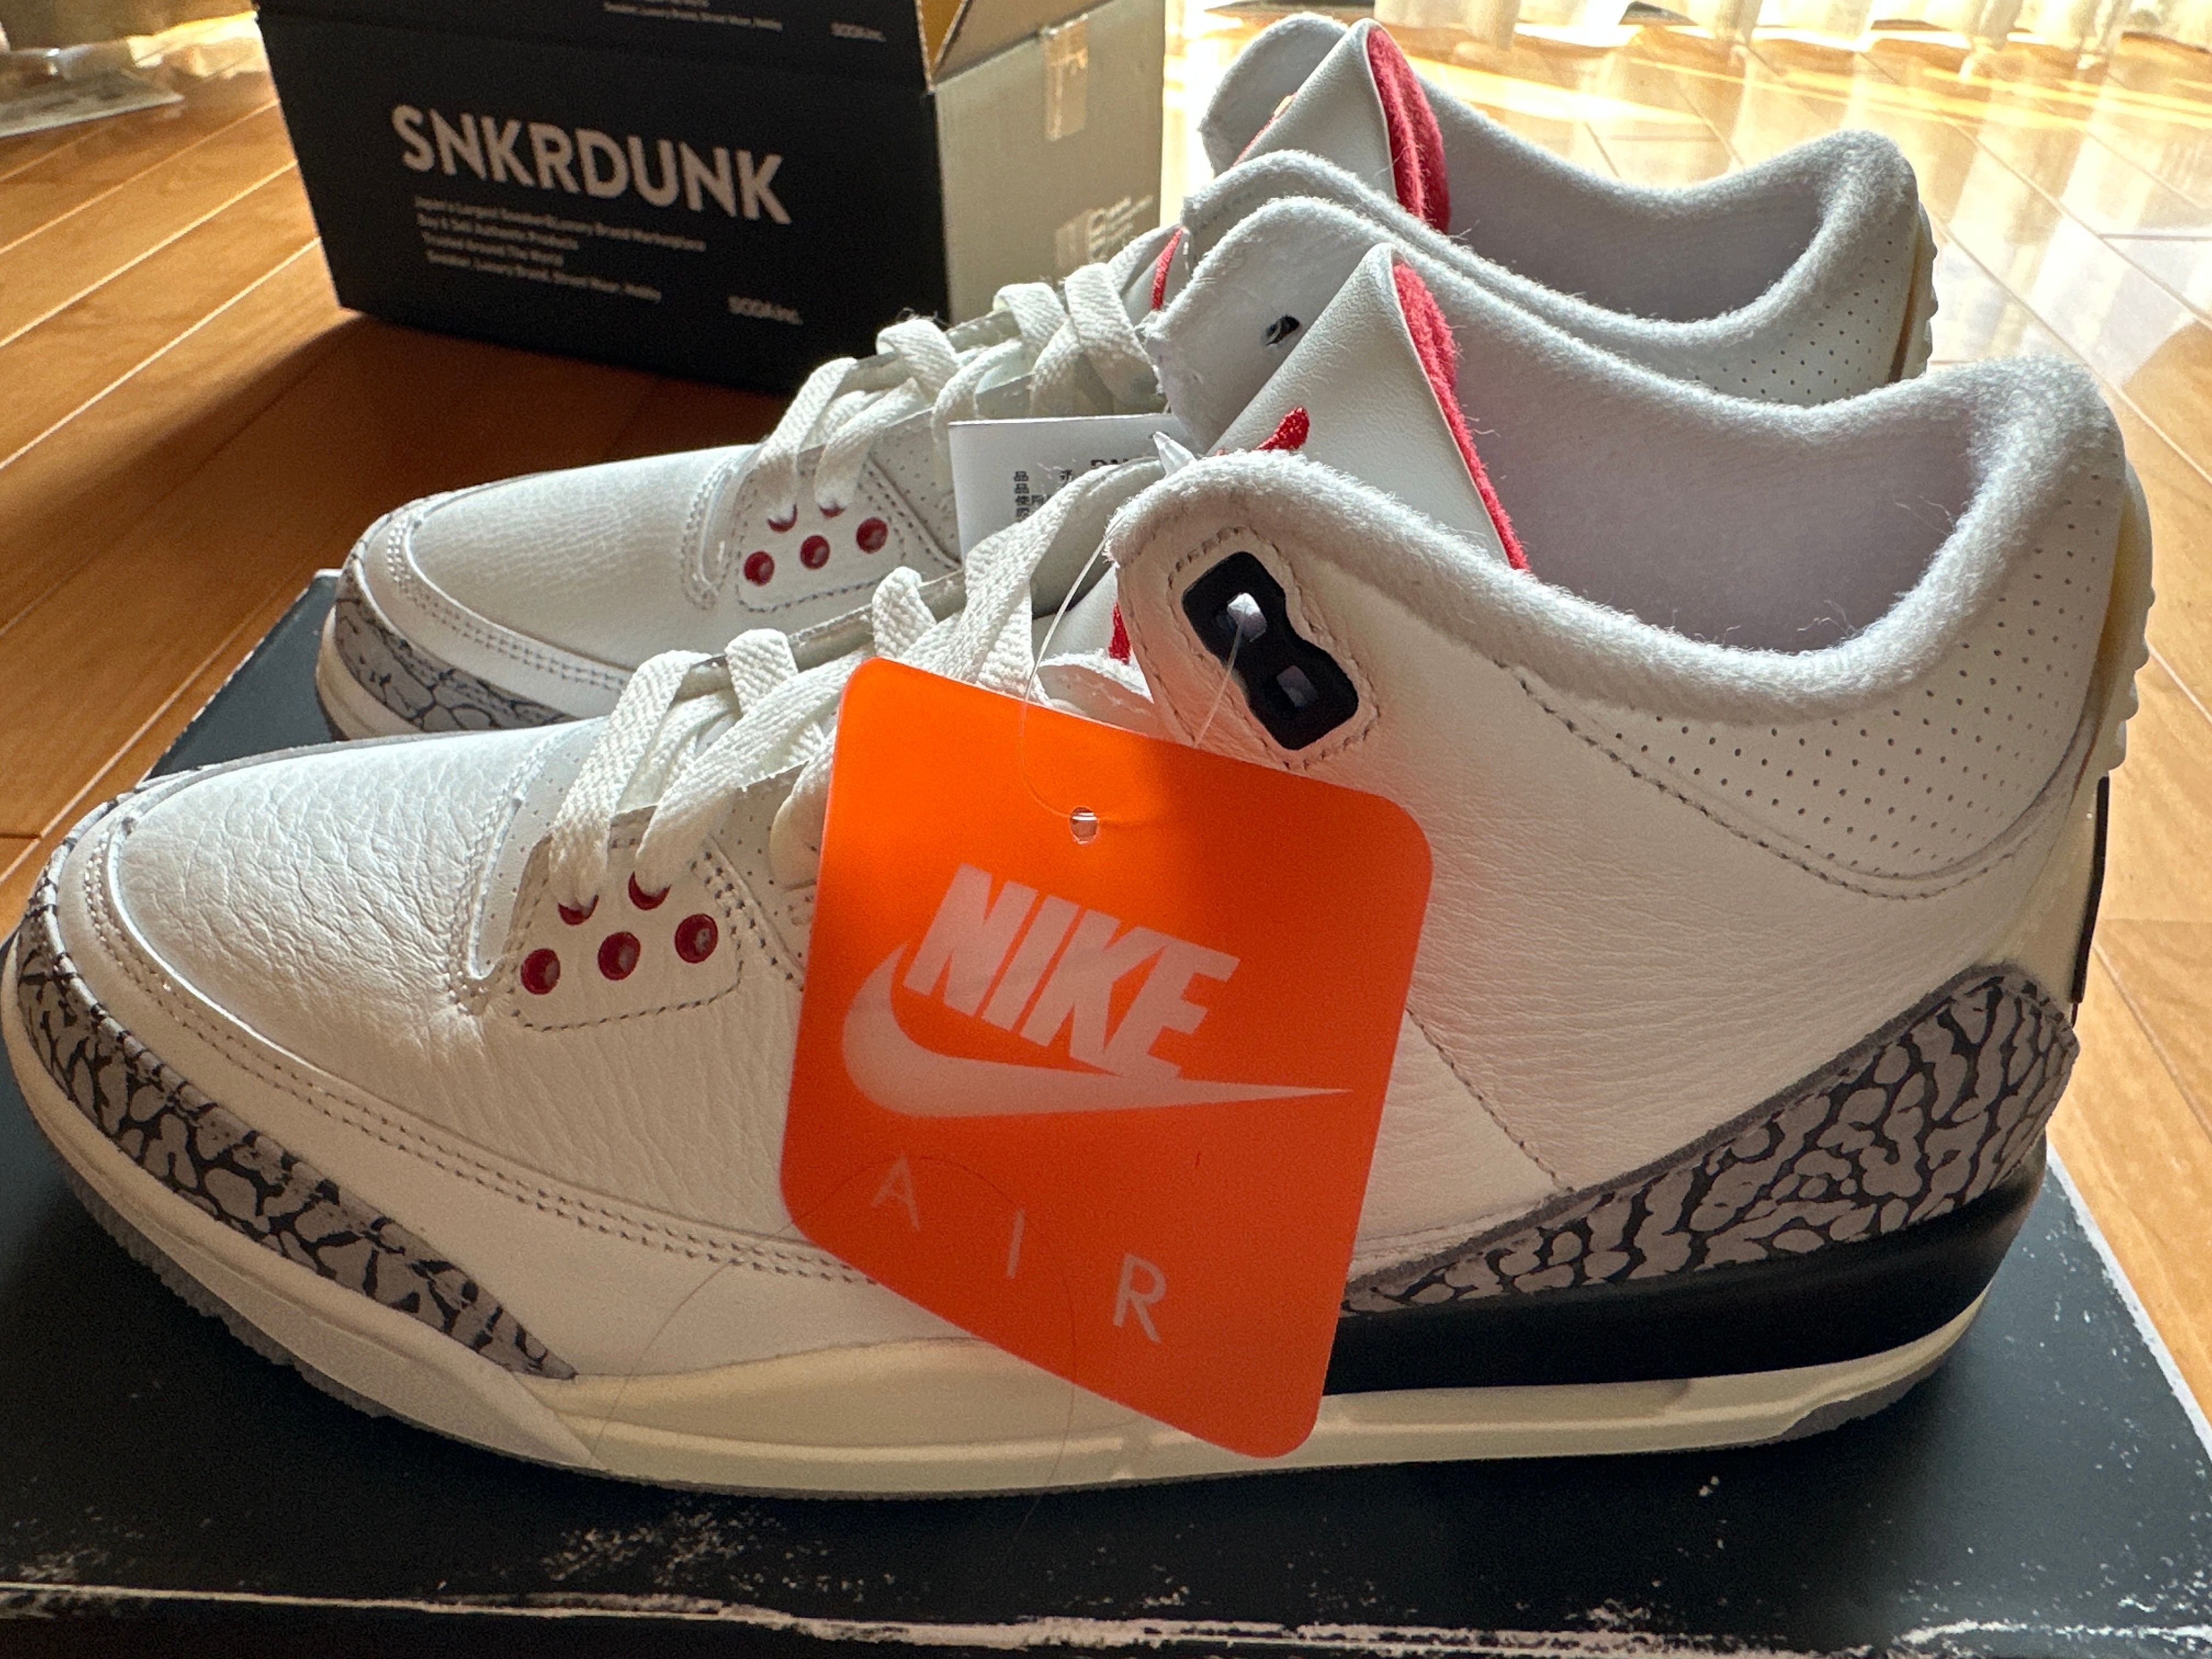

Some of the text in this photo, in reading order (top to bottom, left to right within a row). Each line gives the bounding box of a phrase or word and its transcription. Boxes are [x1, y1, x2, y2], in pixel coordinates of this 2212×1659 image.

[391, 104, 792, 225] SNKRDUNK
[903, 863, 1240, 1079] NIKE
[872, 1152, 1166, 1344] AIR
